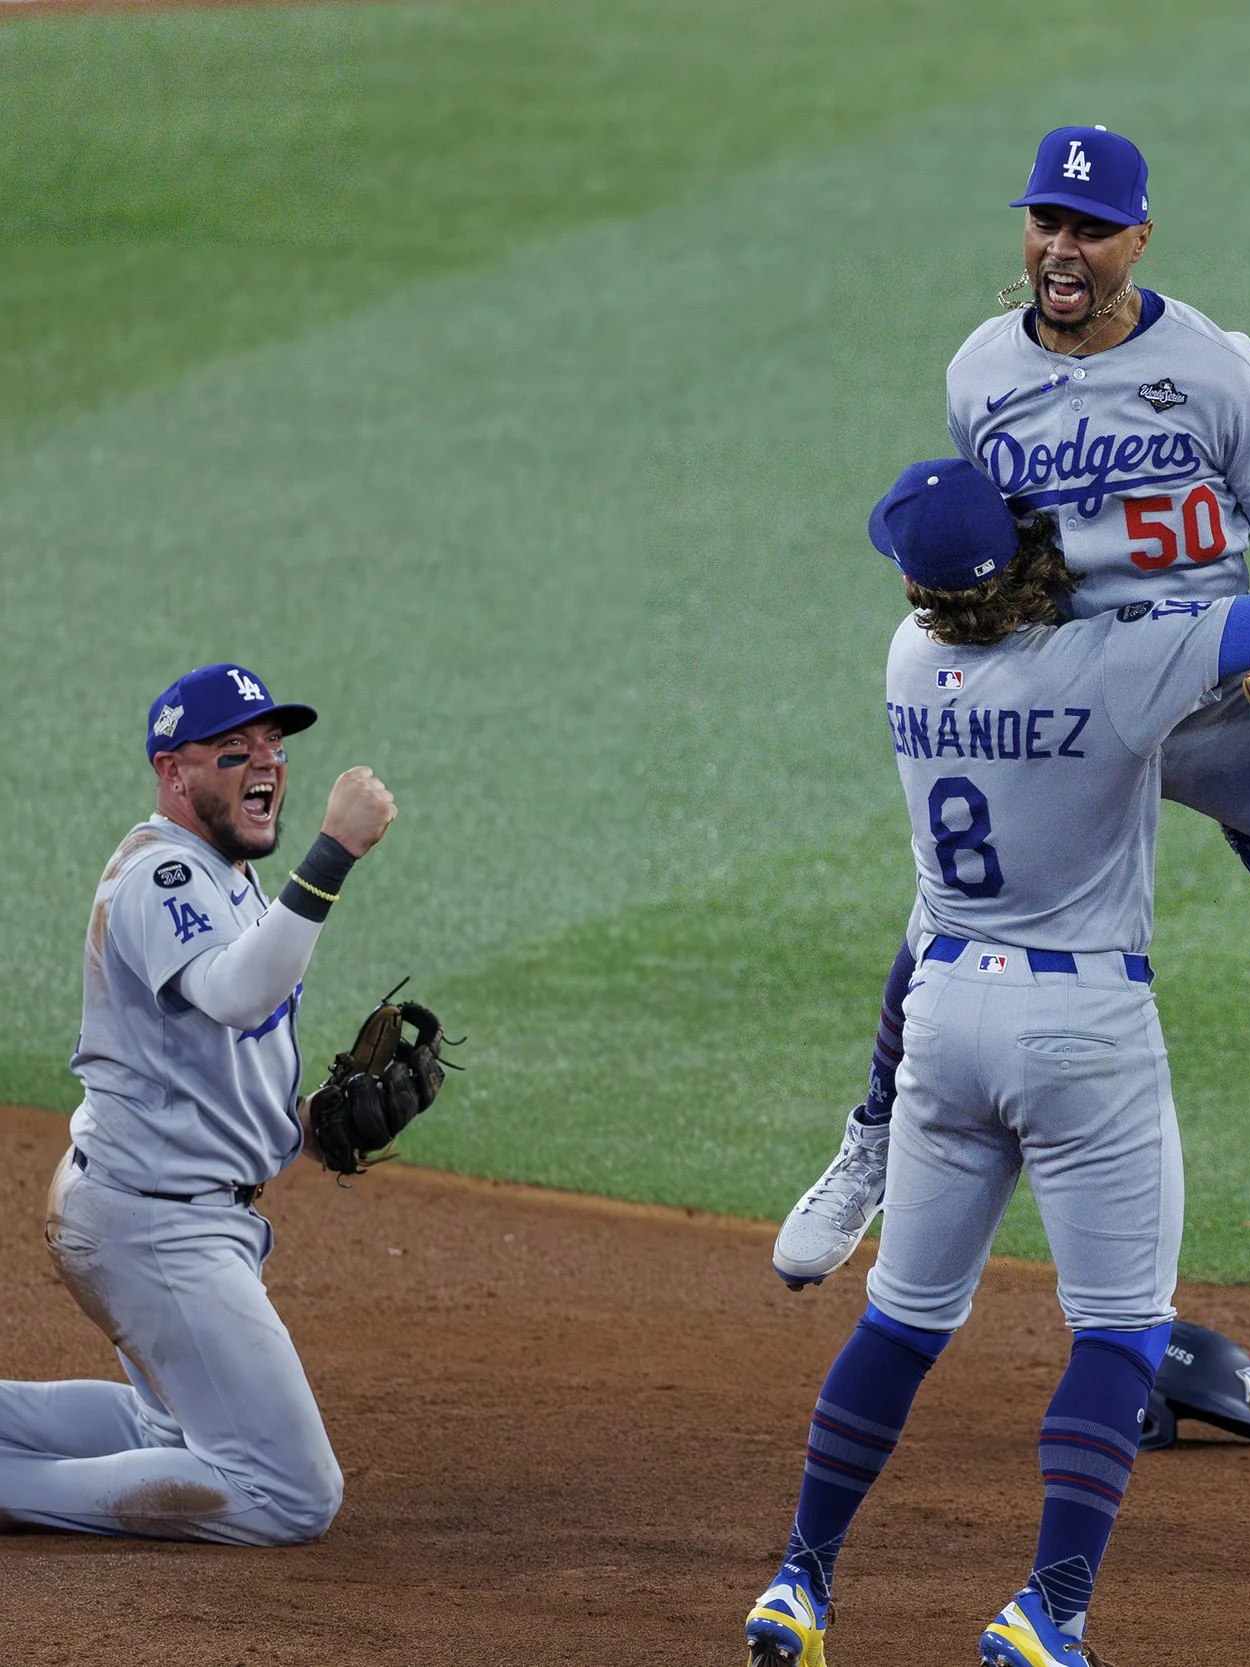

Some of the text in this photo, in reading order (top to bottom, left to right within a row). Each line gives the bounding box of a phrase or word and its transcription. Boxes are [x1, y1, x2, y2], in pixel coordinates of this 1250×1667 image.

[1063, 141, 1092, 181] LA
[1140, 385, 1185, 403] World Series
[978, 416, 1201, 519] Dodgers
[1123, 484, 1227, 570] 50
[226, 668, 265, 701] LA
[928, 776, 1005, 898] 8
[160, 868, 186, 885] 34
[162, 896, 213, 945] LA
[1165, 1343, 1195, 1366] USS
